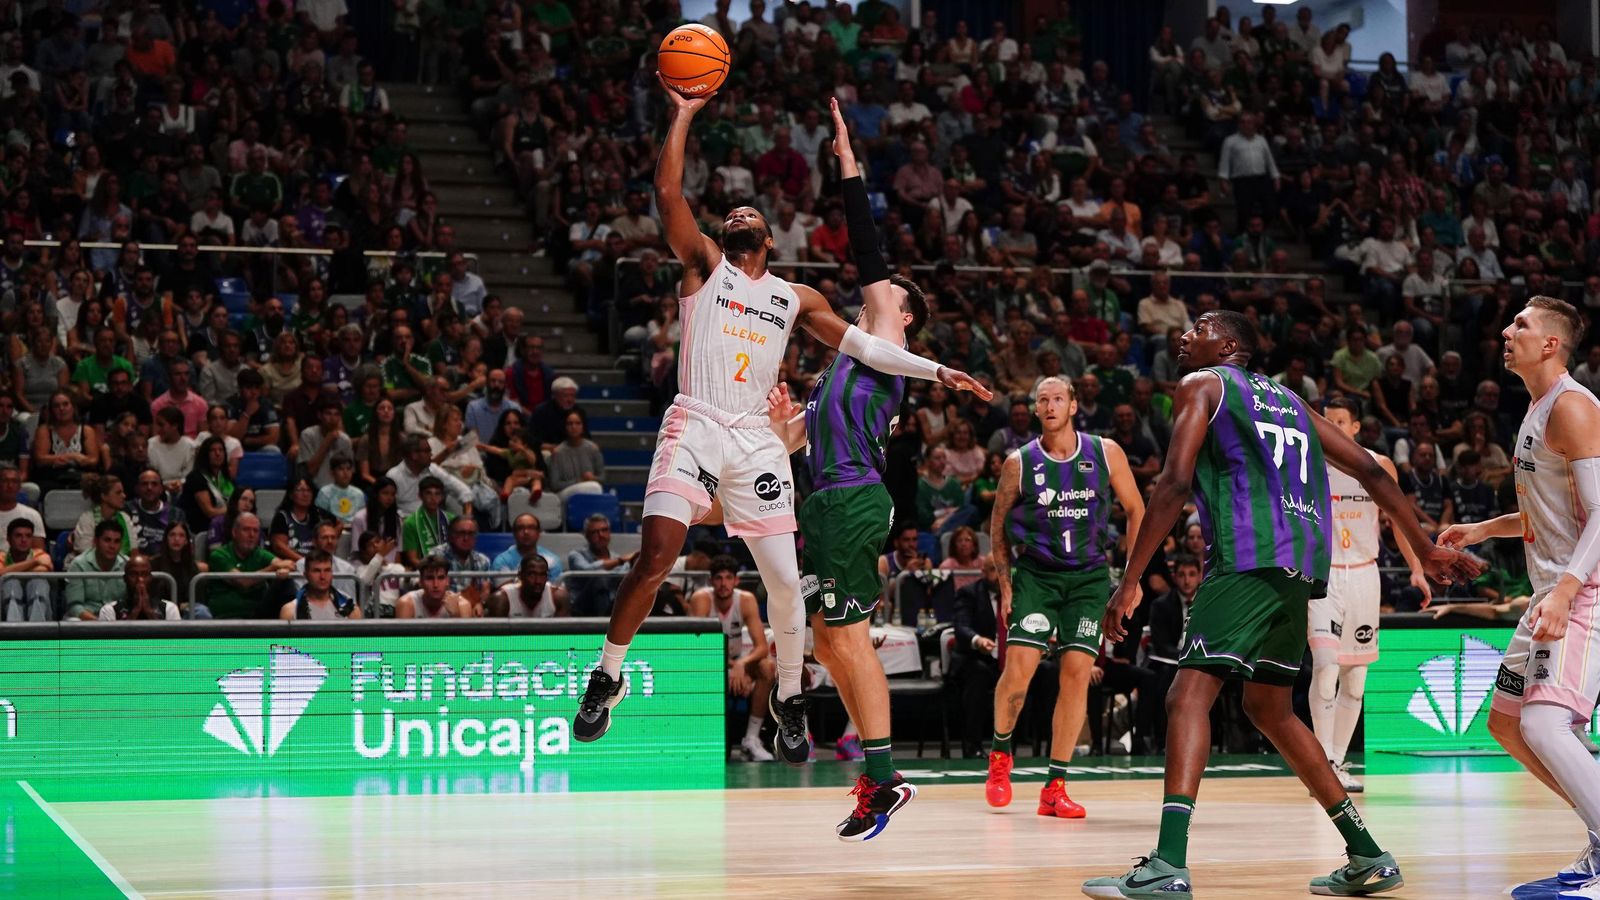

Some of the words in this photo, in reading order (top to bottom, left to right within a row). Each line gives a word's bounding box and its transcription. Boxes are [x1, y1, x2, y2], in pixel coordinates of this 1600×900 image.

[734, 352, 751, 383] 2
[1254, 421, 1308, 484] 77
[756, 479, 780, 494] Q2
[1057, 487, 1095, 502] Unicaja
[1048, 506, 1088, 520] málaga
[1062, 529, 1071, 553] 1
[1341, 527, 1351, 549] 8
[1355, 629, 1373, 640] Q2
[1498, 671, 1523, 689] PONS
[351, 705, 571, 770] Unicaja
